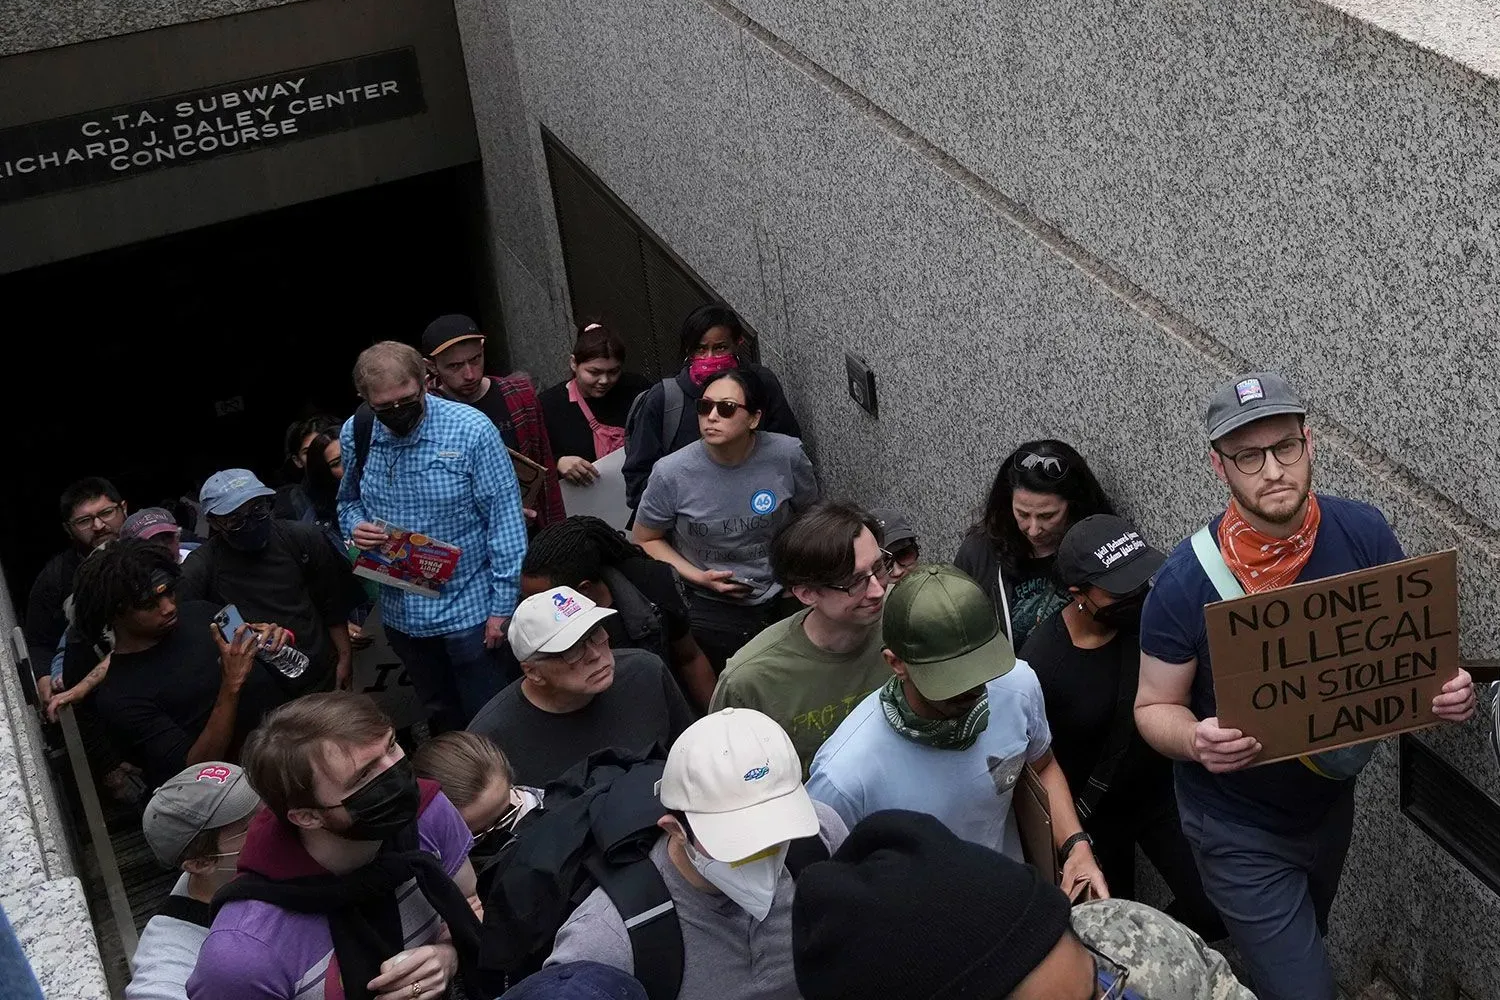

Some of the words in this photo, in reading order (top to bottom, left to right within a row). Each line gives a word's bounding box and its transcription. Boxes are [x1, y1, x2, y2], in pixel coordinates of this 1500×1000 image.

[80, 109, 166, 138] C.T.A.
[175, 77, 306, 119] SUBWAY
[141, 131, 165, 148] J.
[172, 104, 277, 141] DALEY
[289, 79, 401, 116] CENTER
[109, 118, 300, 173] CONCOURSE
[689, 521, 708, 537] NO
[755, 495, 771, 507] 46
[1094, 546, 1108, 561] Well
[1106, 532, 1130, 552] Behaved
[1101, 552, 1122, 568] Seldom
[1228, 599, 1290, 636] NO
[1303, 580, 1382, 622] ONE
[1396, 569, 1433, 603] IS
[1261, 605, 1451, 673] ILLEGAL
[1251, 675, 1307, 711] ON
[1317, 646, 1437, 697] STOLEN
[1308, 687, 1418, 744] LAND!
[197, 765, 232, 784] B
